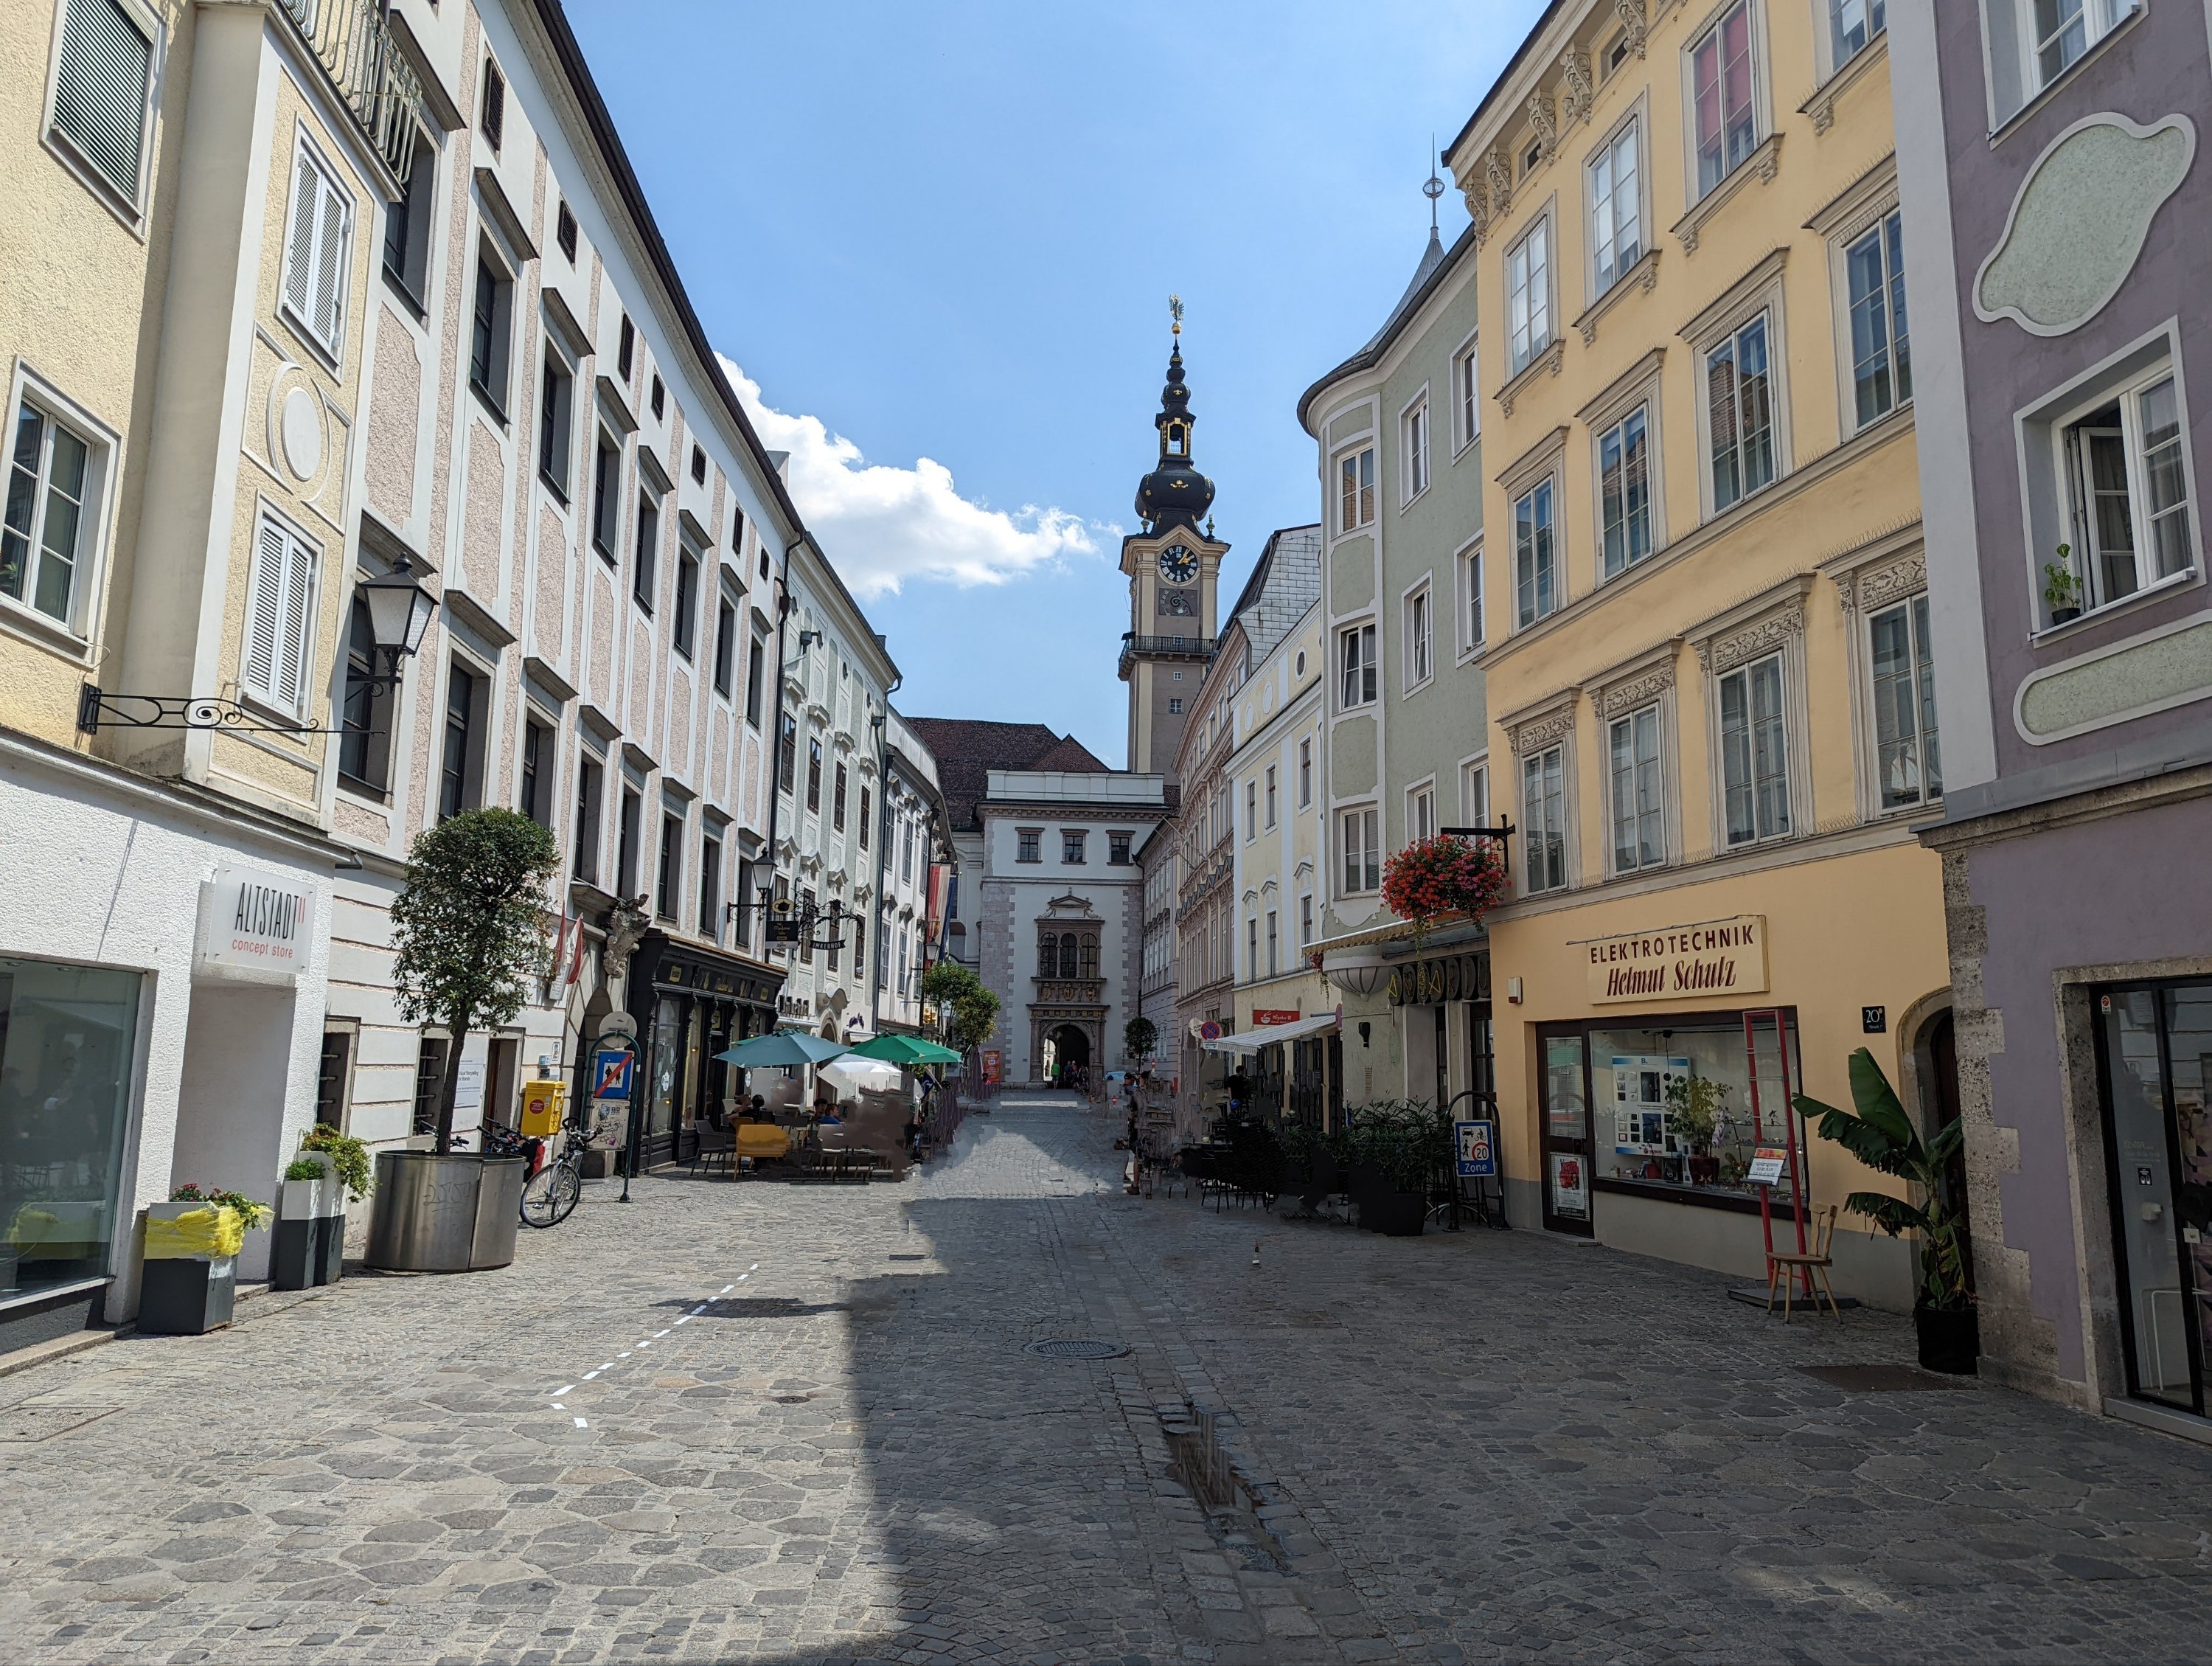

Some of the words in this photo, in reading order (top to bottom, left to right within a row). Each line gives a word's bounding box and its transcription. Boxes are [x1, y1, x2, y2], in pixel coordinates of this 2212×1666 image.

[232, 938, 269, 957] concept
[271, 945, 293, 959] store
[1590, 924, 1754, 964] ELEKTROTECHNIK
[1607, 965, 1666, 996] Helmut
[1674, 955, 1736, 991] Schulz
[1865, 1009, 1880, 1024] 20
[1476, 1148, 1487, 1159] 20
[1464, 1162, 1487, 1173] Zone
